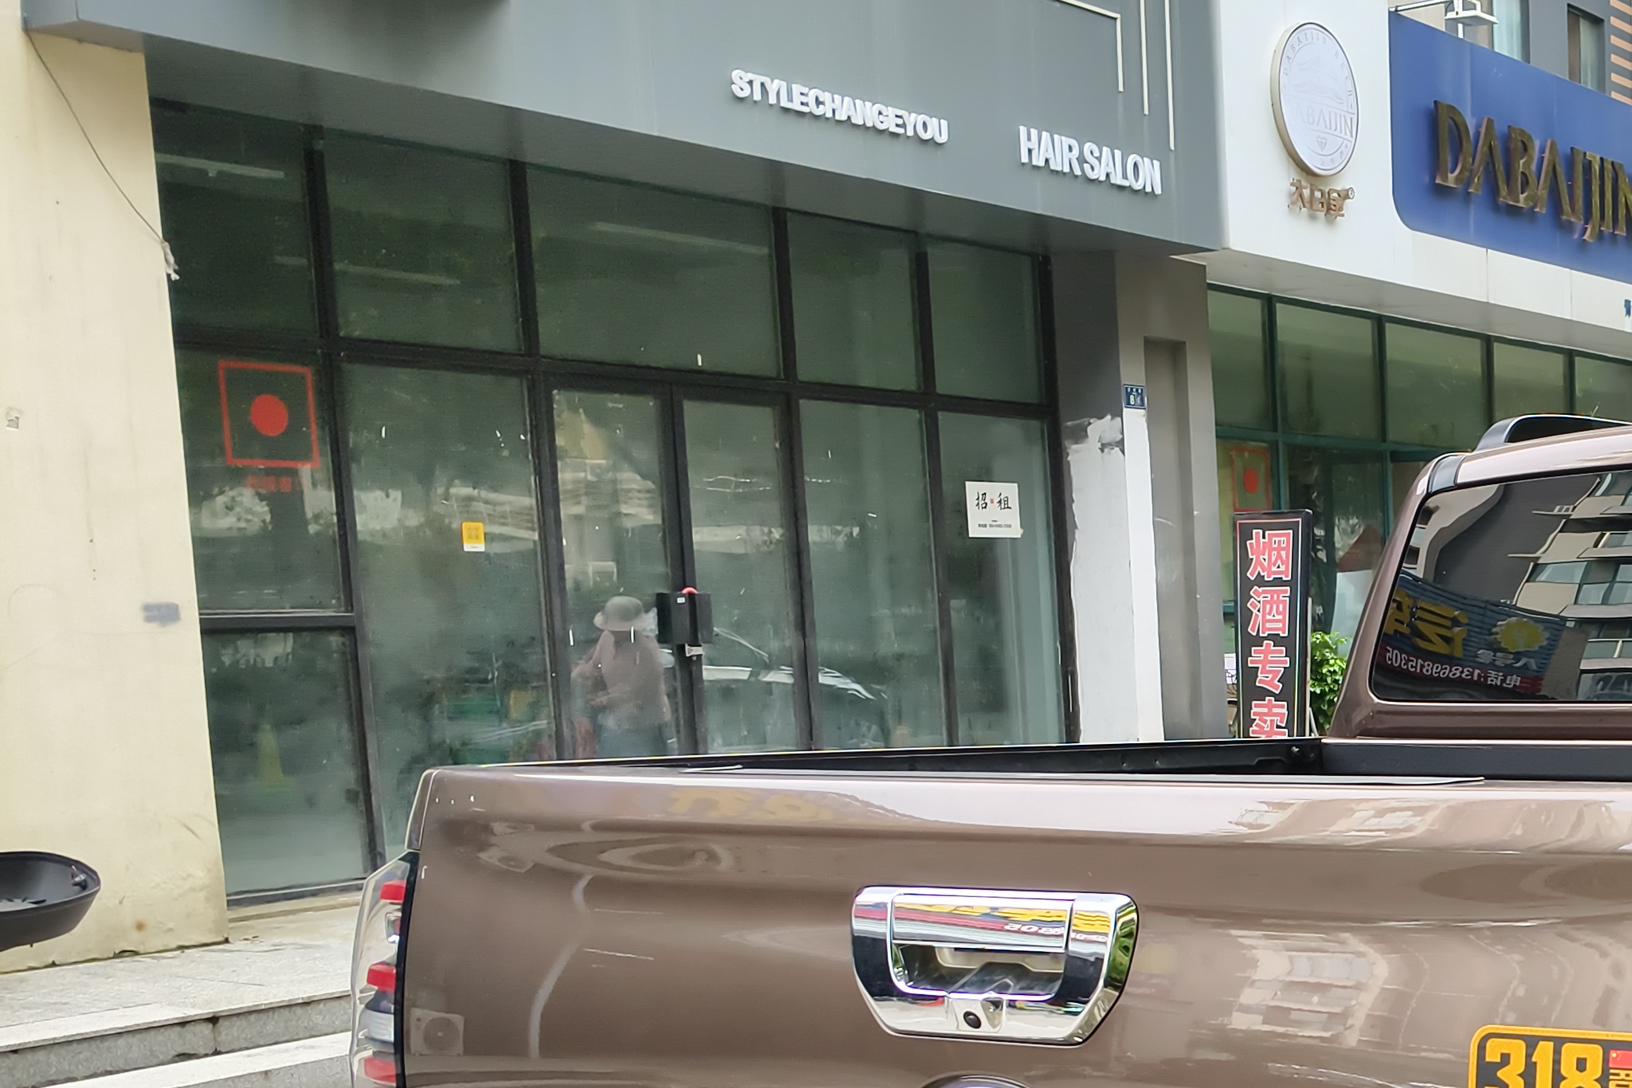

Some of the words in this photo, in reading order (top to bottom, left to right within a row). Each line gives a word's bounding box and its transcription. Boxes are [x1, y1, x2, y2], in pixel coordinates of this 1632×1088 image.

[730, 69, 949, 144] STYLECHANGEYOU
[1019, 125, 1082, 176] HAIR
[1083, 142, 1162, 195] SALON
[1247, 529, 1293, 739] 烟酒专卖
